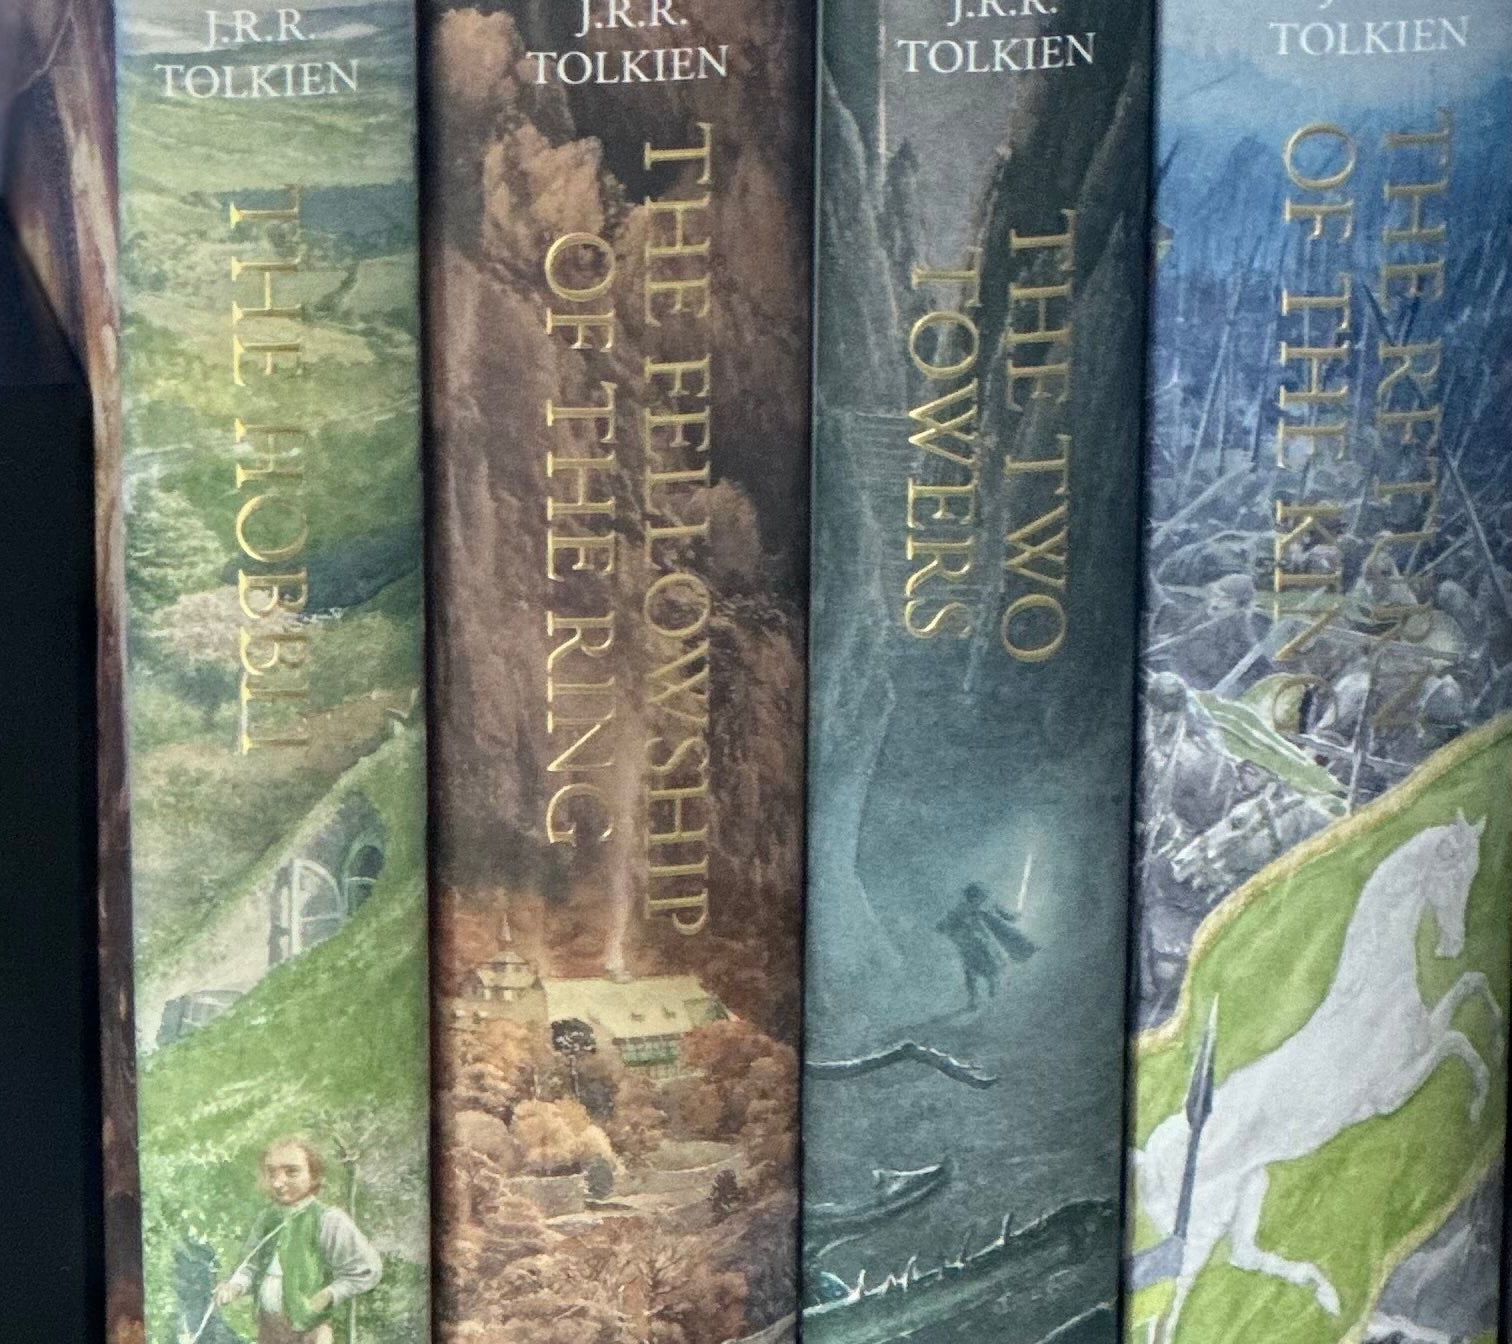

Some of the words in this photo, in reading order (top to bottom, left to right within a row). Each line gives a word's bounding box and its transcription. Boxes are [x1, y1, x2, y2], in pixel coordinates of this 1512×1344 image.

[154, 58, 360, 99] TOLKIEN
[204, 7, 316, 50] J.R.R.
[526, 44, 728, 85] TOLKIEN
[898, 32, 1096, 75] TOLKIEN
[1269, 15, 1469, 56] TOLKIEN
[644, 123, 713, 326] THE
[1284, 121, 1356, 245] OF
[1380, 105, 1454, 318] THE
[229, 183, 303, 387] THE
[545, 231, 617, 354] OF
[1004, 209, 1078, 412] THE
[1278, 271, 1354, 469] THE
[546, 380, 616, 583] THE
[903, 246, 982, 642] TOWERS
[234, 417, 308, 755] HOBBIT
[642, 355, 713, 937] FELLOWSHIP
[1000, 434, 1073, 664] TWO
[545, 611, 616, 849] RING
